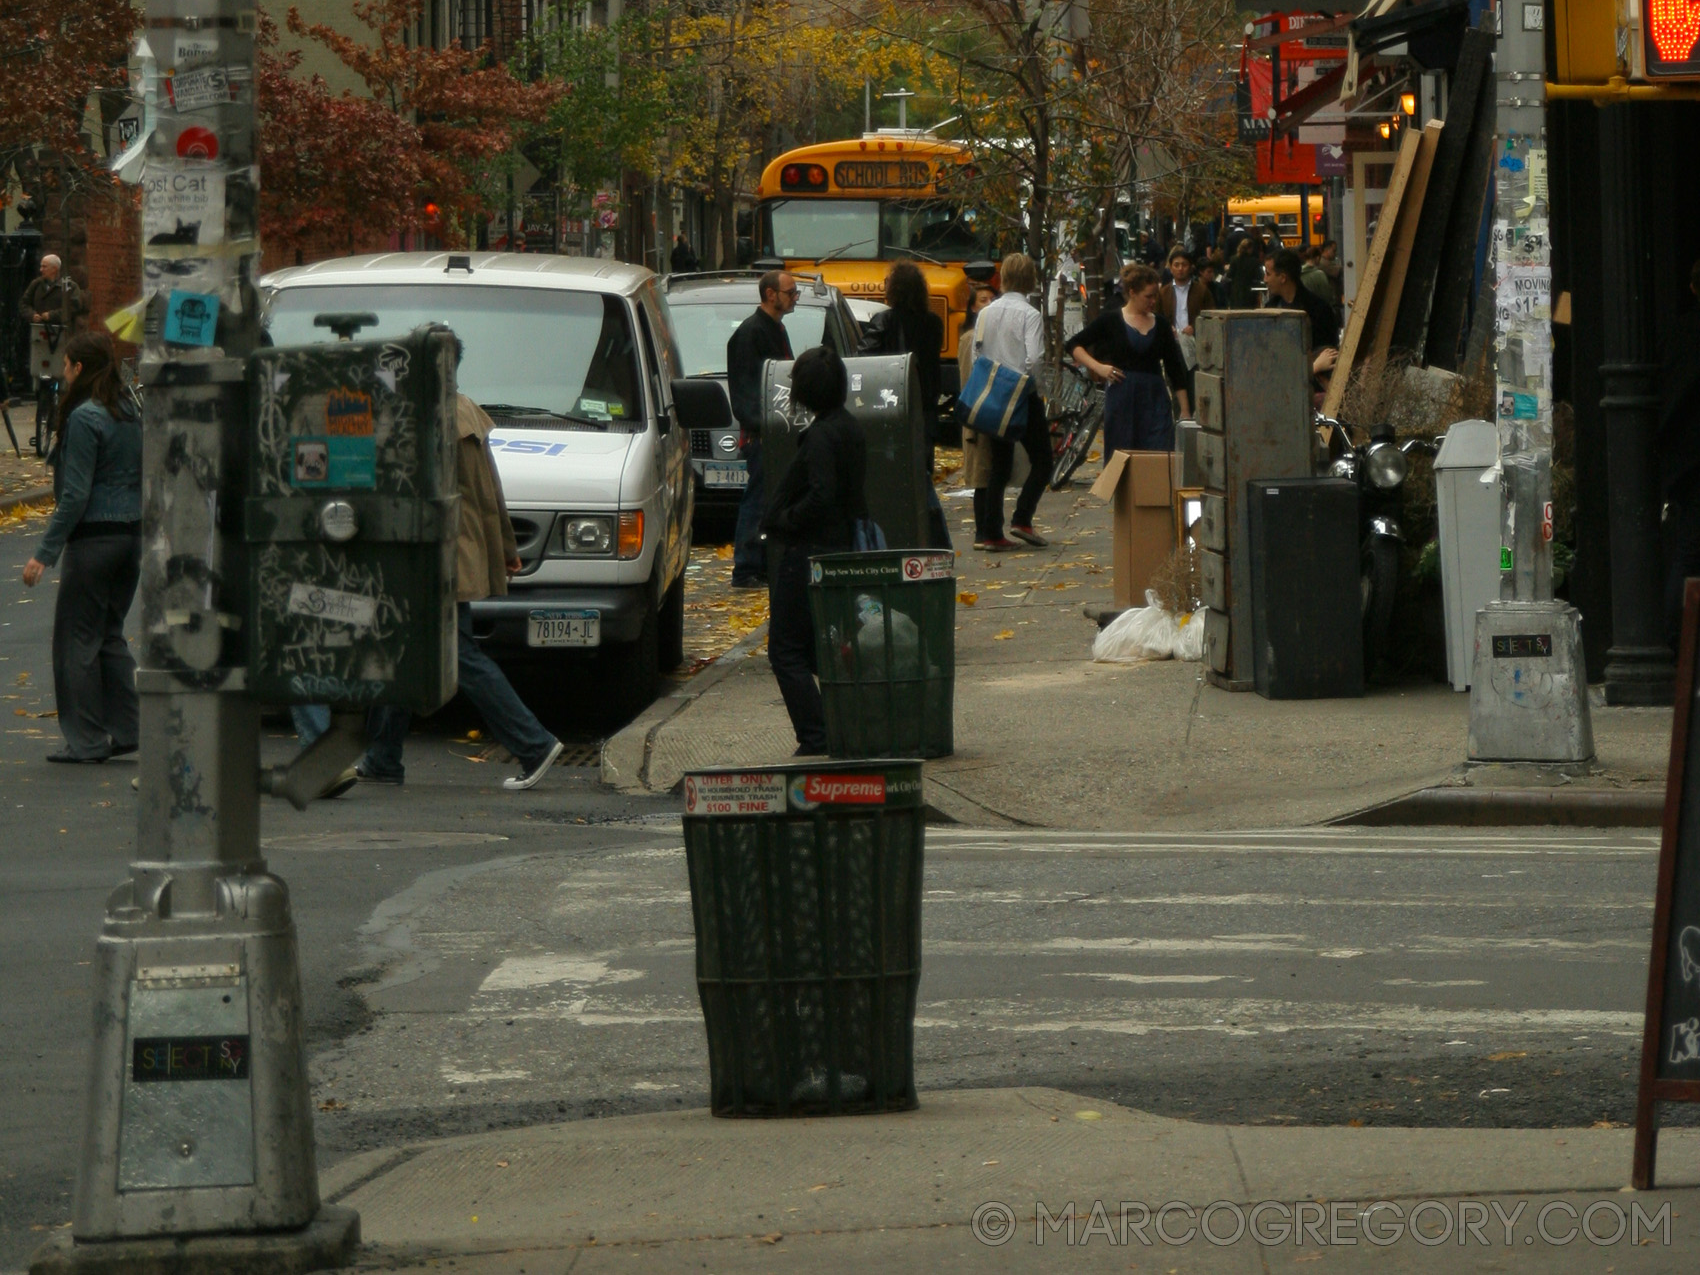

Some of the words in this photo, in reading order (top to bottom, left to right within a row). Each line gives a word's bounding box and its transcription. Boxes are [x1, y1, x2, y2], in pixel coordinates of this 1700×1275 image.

[838, 163, 888, 186] SCHOOL
[147, 175, 167, 193] ost
[173, 174, 206, 192] Cat
[526, 224, 549, 232] JAY-Z
[865, 567, 879, 576] City
[880, 566, 899, 574] Clean
[702, 775, 732, 785] LITTER
[740, 773, 775, 784] ONLY
[708, 786, 750, 794] HOUSEHOLD
[753, 785, 783, 793] TRASH
[809, 777, 882, 801] Supreme
[886, 782, 899, 794] ork
[712, 794, 746, 802] BUSINESS
[706, 802, 732, 813] $100
[738, 801, 770, 812] FINE
